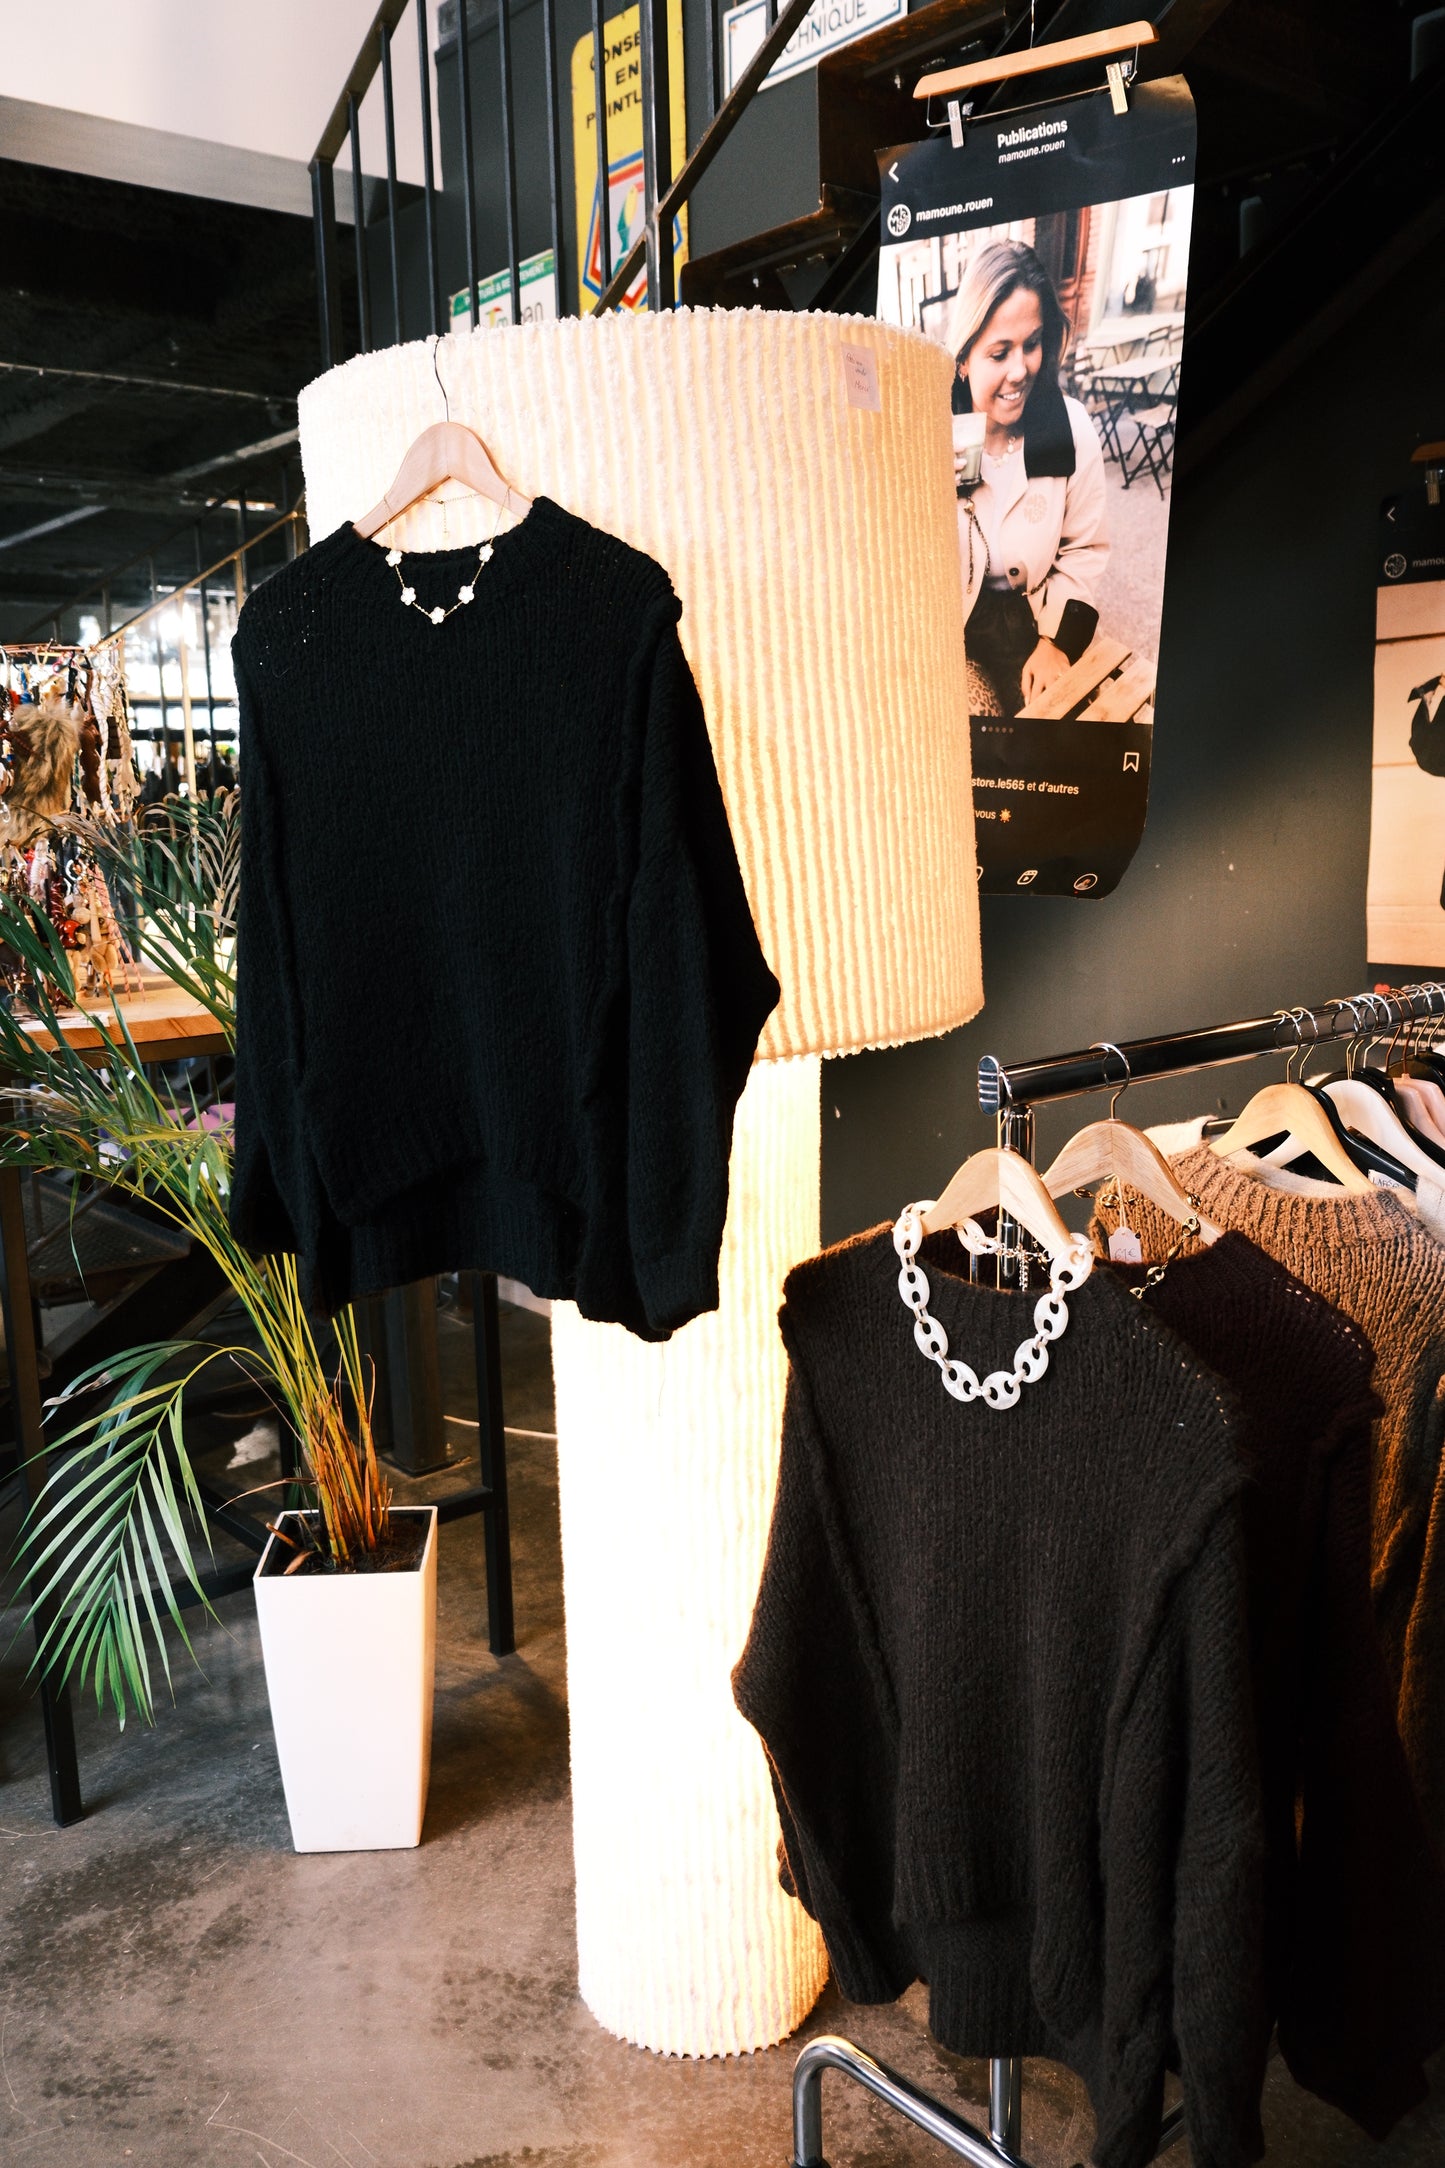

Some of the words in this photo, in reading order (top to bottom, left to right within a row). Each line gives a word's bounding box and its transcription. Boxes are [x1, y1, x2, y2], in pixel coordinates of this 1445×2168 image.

[615, 60, 639, 86] EN
[997, 120, 1068, 149] Publications
[998, 139, 1066, 164] mamoune.rouen
[916, 197, 994, 222] mamoune.rouen
[1026, 782, 1037, 792] et
[1038, 781, 1080, 796] d'autres
[975, 809, 997, 820] vous
